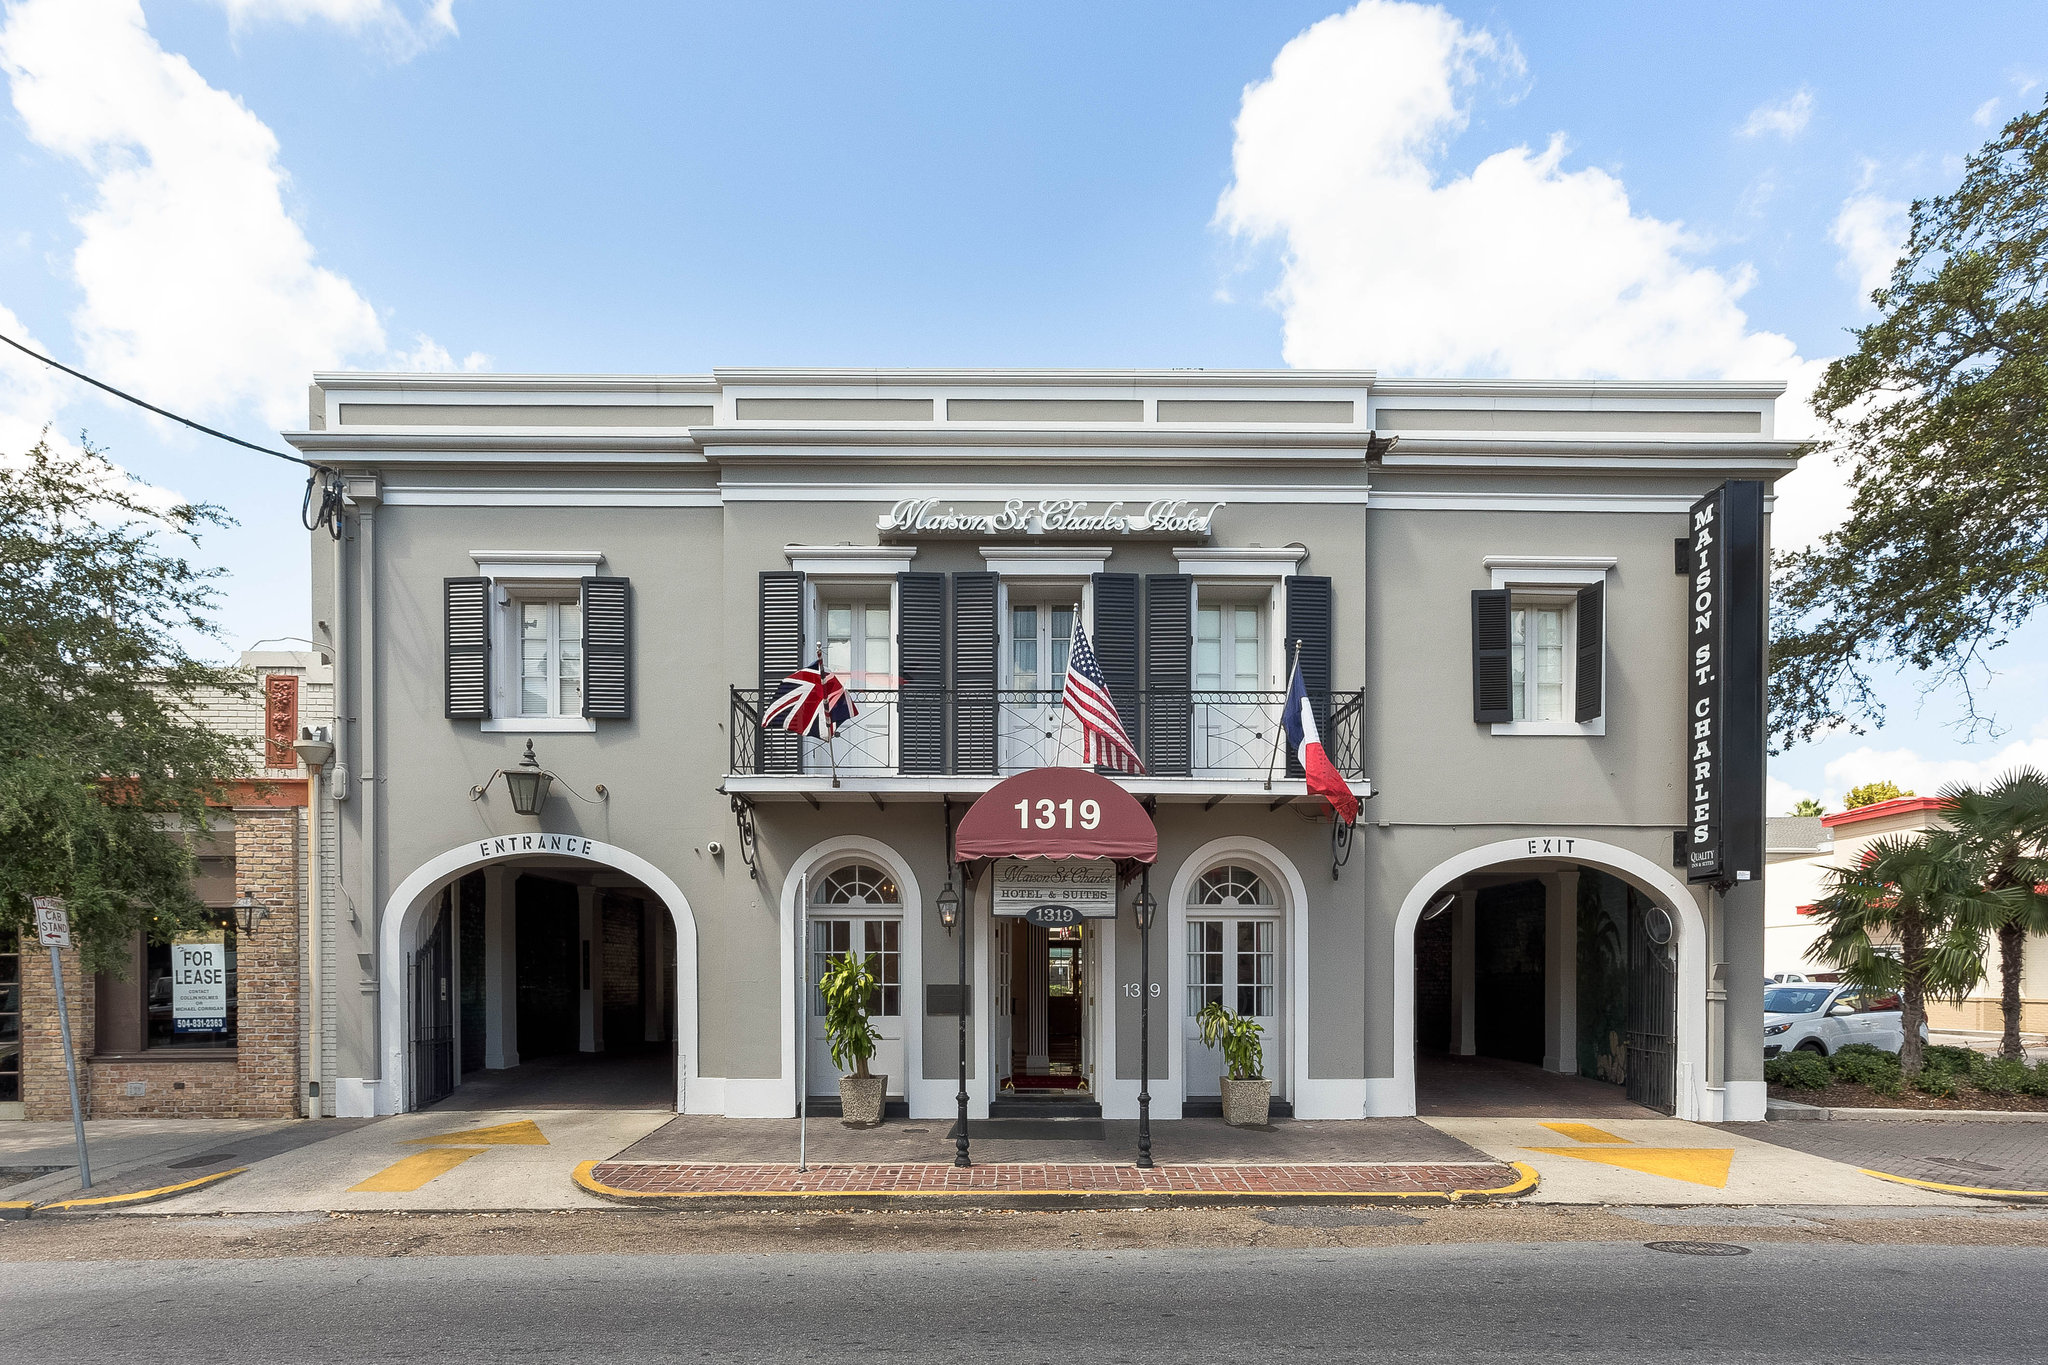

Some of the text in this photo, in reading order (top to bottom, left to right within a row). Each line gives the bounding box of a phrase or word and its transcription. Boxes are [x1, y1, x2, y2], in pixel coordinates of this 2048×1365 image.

[876, 497, 986, 531] Maison
[1039, 498, 1128, 531] Charles
[1129, 498, 1227, 531] Hotel
[1693, 503, 1715, 844] MAISON ST. CHARLES
[1014, 799, 1101, 830] 1319
[480, 835, 592, 857] ENTRANCE
[1528, 839, 1575, 854] EXIT
[1690, 850, 1714, 863] QUALITY
[998, 865, 1051, 883] Maison
[1069, 866, 1112, 884] Charles
[1001, 890, 1108, 899] HOTEL & SUITES
[35, 898, 46, 908] NO
[45, 910, 62, 921] CAB
[1036, 908, 1073, 922] 1319
[41, 921, 67, 933] STAND
[184, 951, 212, 966] FOR
[176, 969, 222, 984] LEASE
[1122, 983, 1160, 998] 139
